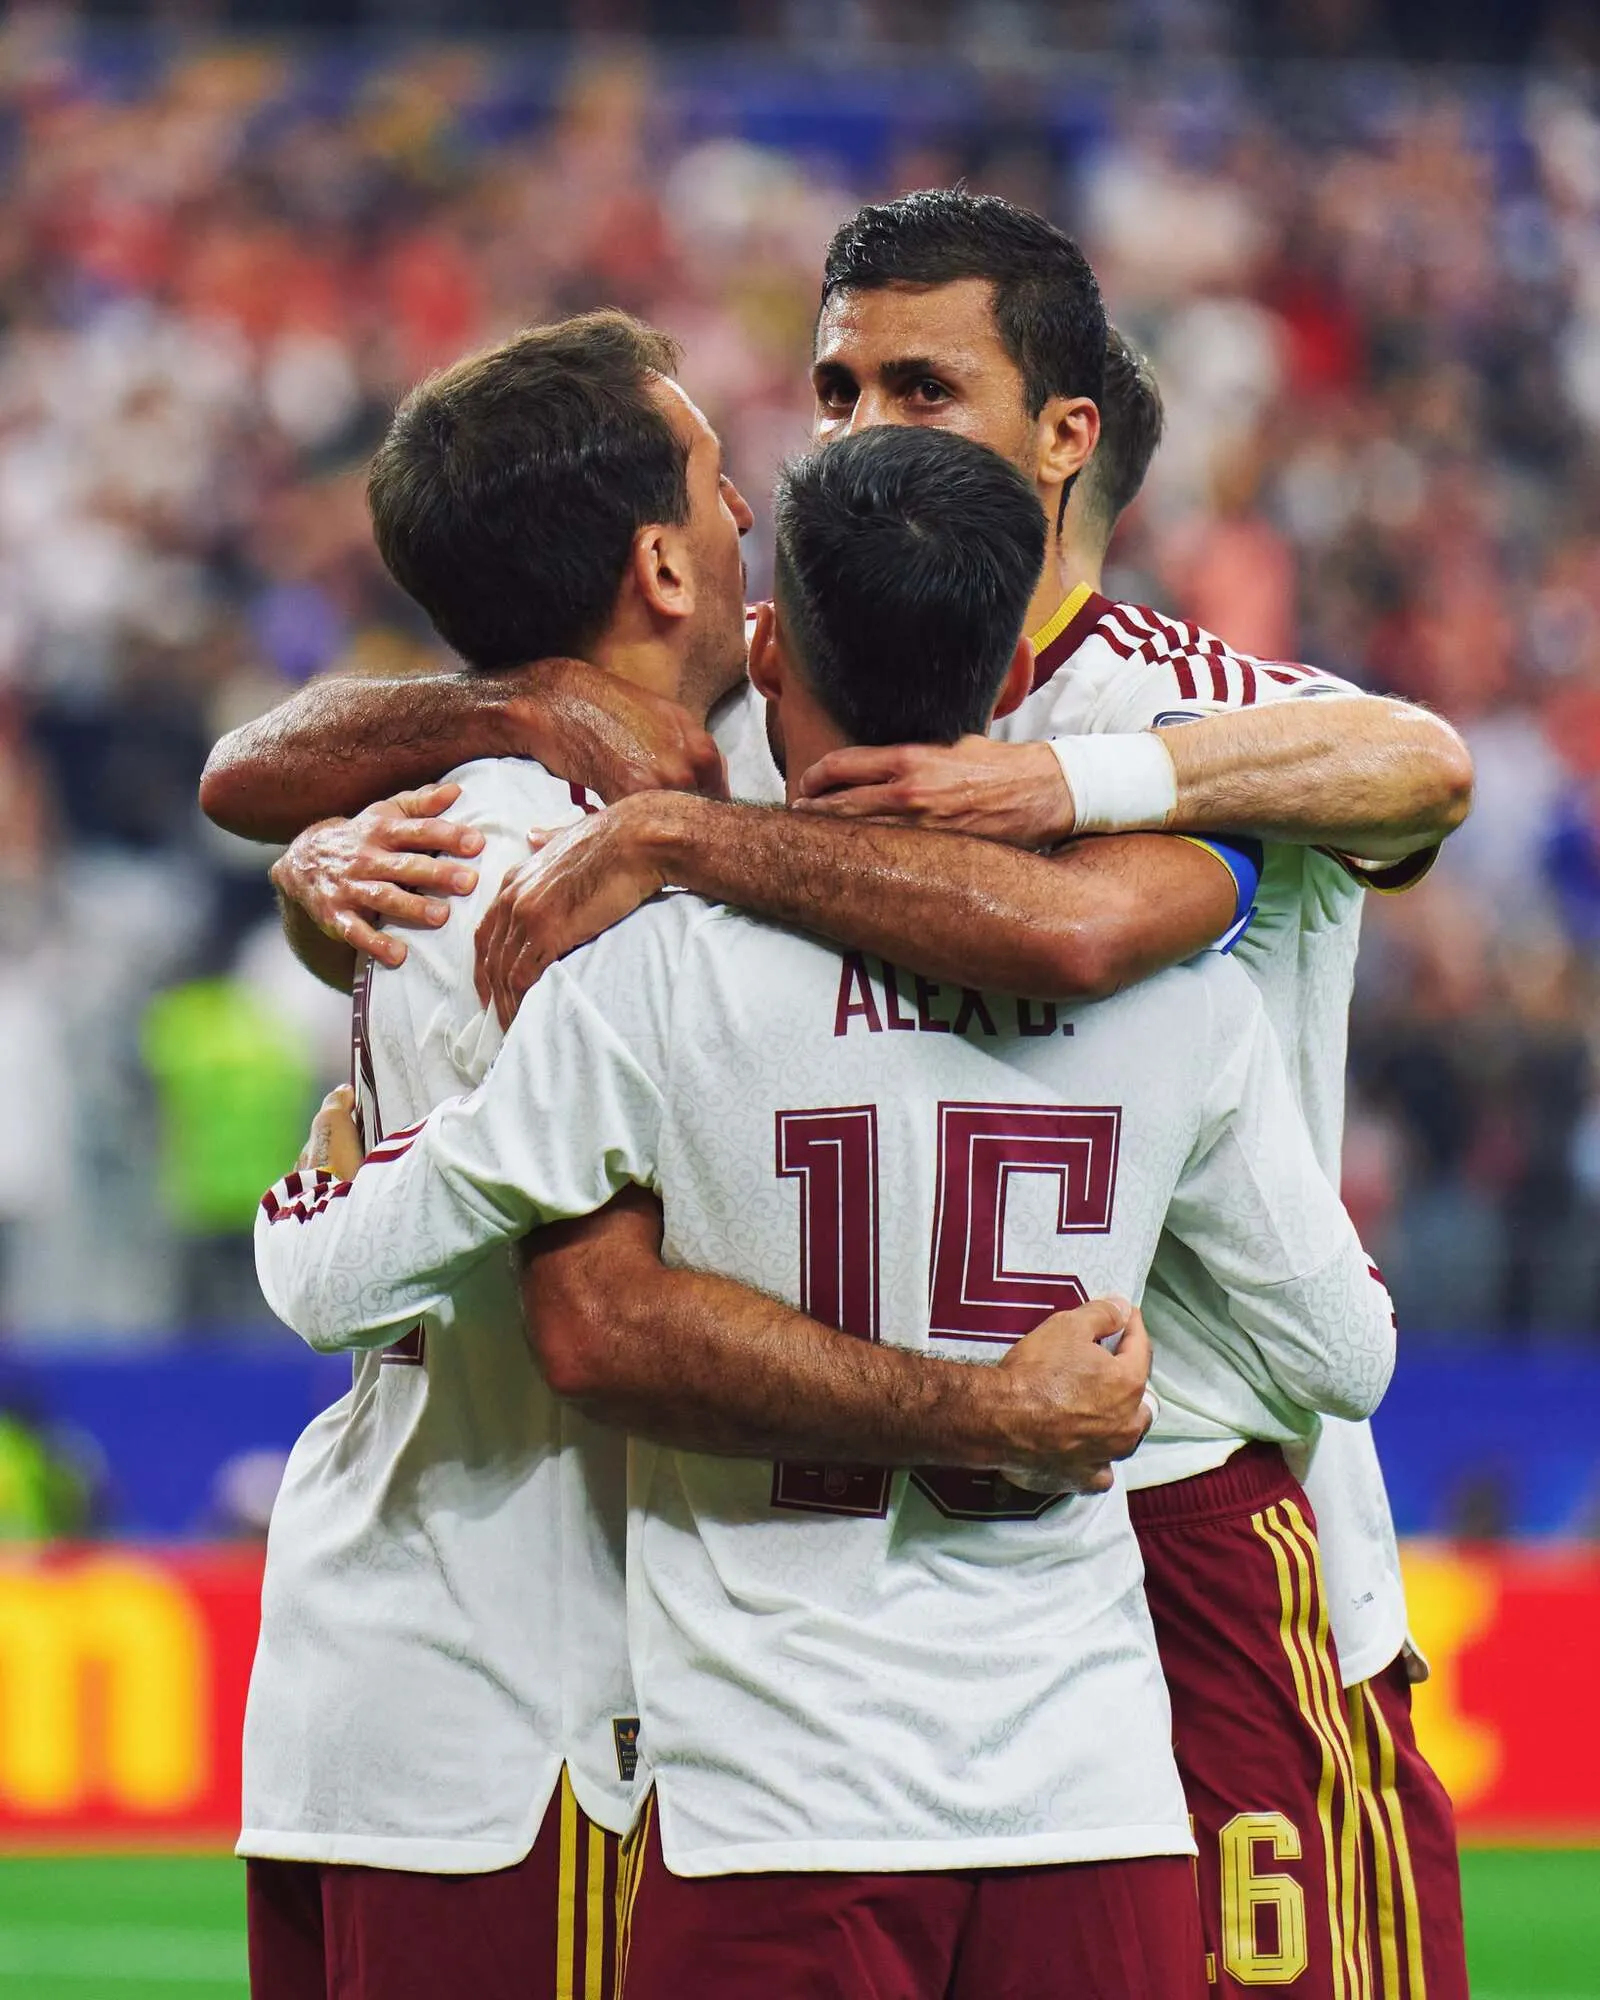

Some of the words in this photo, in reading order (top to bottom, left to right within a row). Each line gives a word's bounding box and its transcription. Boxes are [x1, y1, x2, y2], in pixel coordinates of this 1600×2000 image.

[834, 951, 998, 1036] ALEX
[770, 1101, 1122, 1522] 15
[1189, 1811, 1308, 1986] 6
